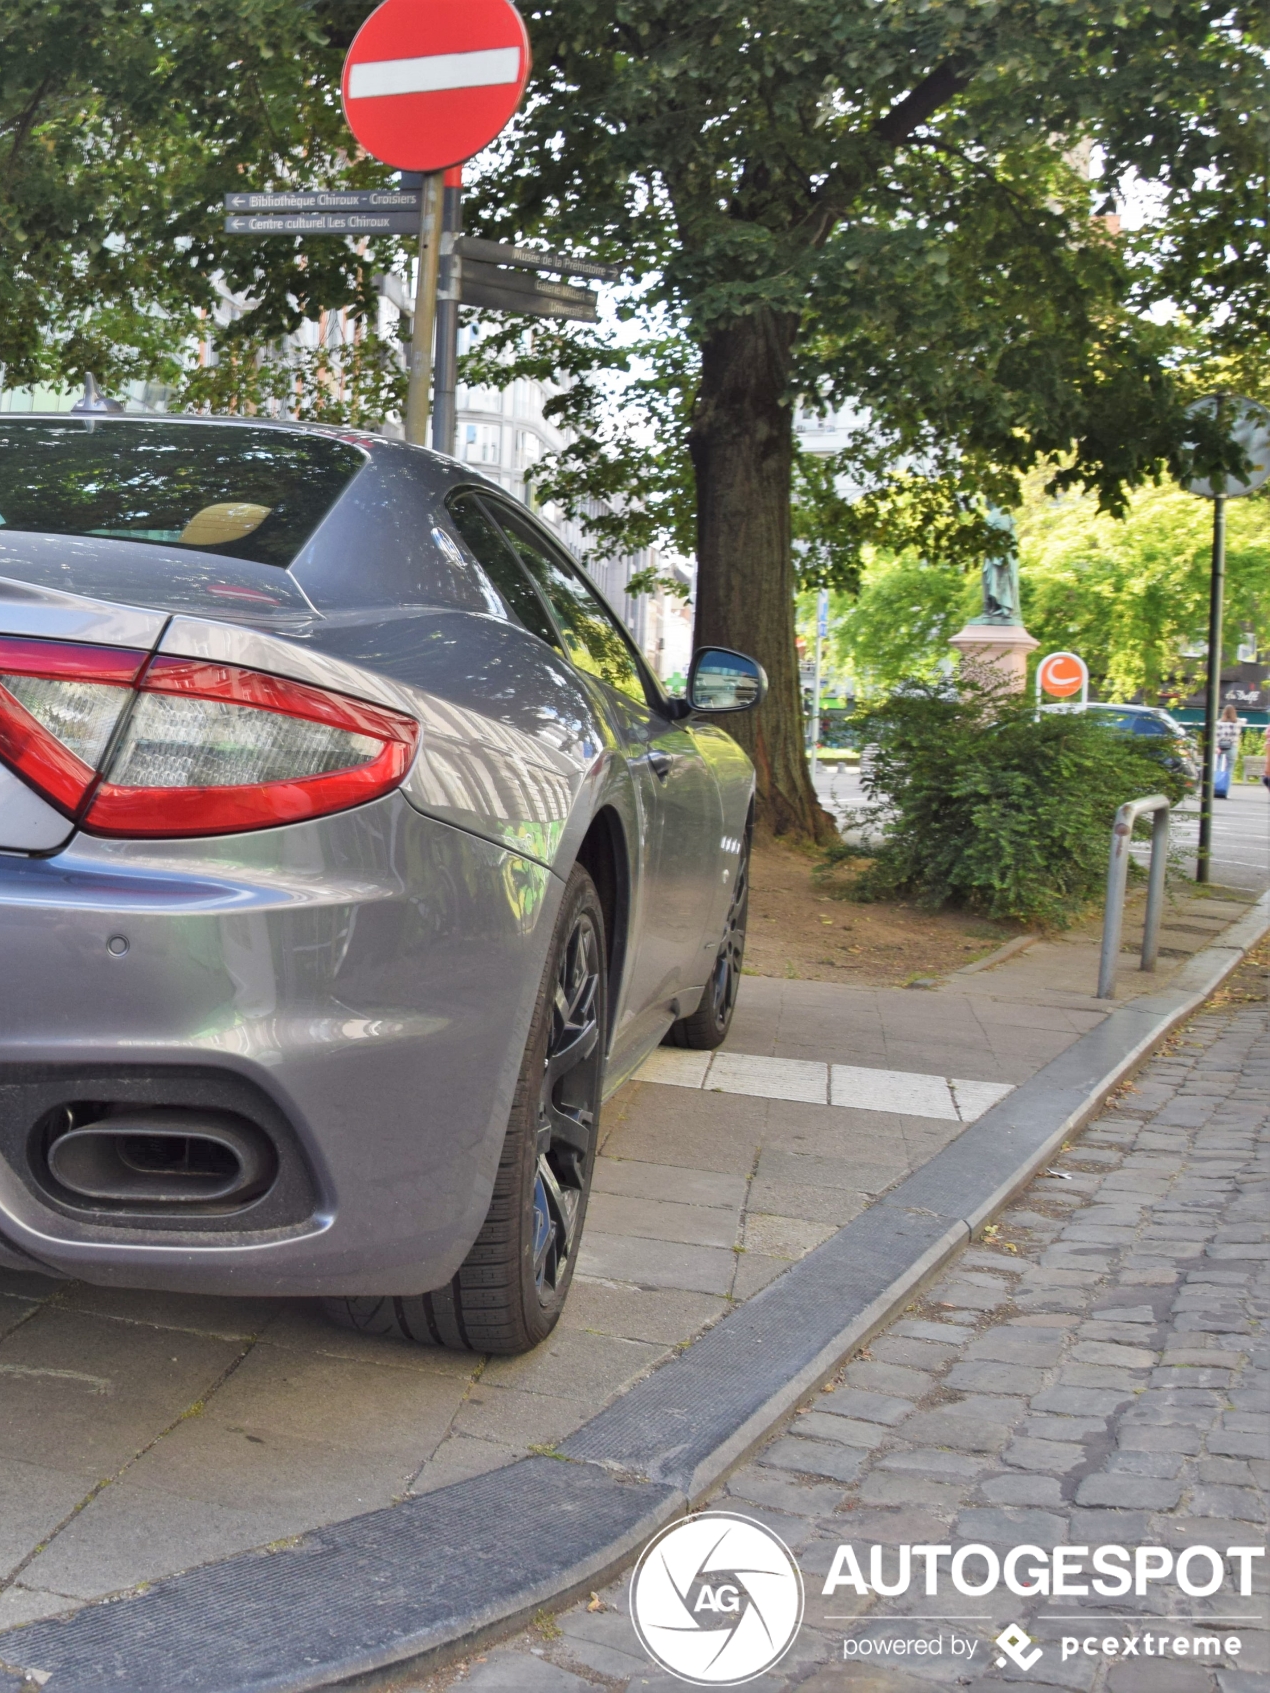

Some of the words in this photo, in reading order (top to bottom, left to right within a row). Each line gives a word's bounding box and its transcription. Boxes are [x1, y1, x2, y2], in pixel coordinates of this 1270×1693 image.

[249, 194, 315, 209] Bibliothèque
[317, 193, 359, 206] Chiroux
[370, 192, 417, 205] Croisiers
[249, 218, 283, 230] Centre
[285, 217, 325, 229] culturel
[327, 216, 346, 228] Les
[348, 215, 390, 227] Chiroux
[512, 249, 541, 264] Musée
[542, 253, 552, 266] de
[554, 255, 563, 268] la
[563, 257, 606, 276] Préhistoire
[535, 280, 561, 294] Galerie
[549, 301, 583, 317] Université
